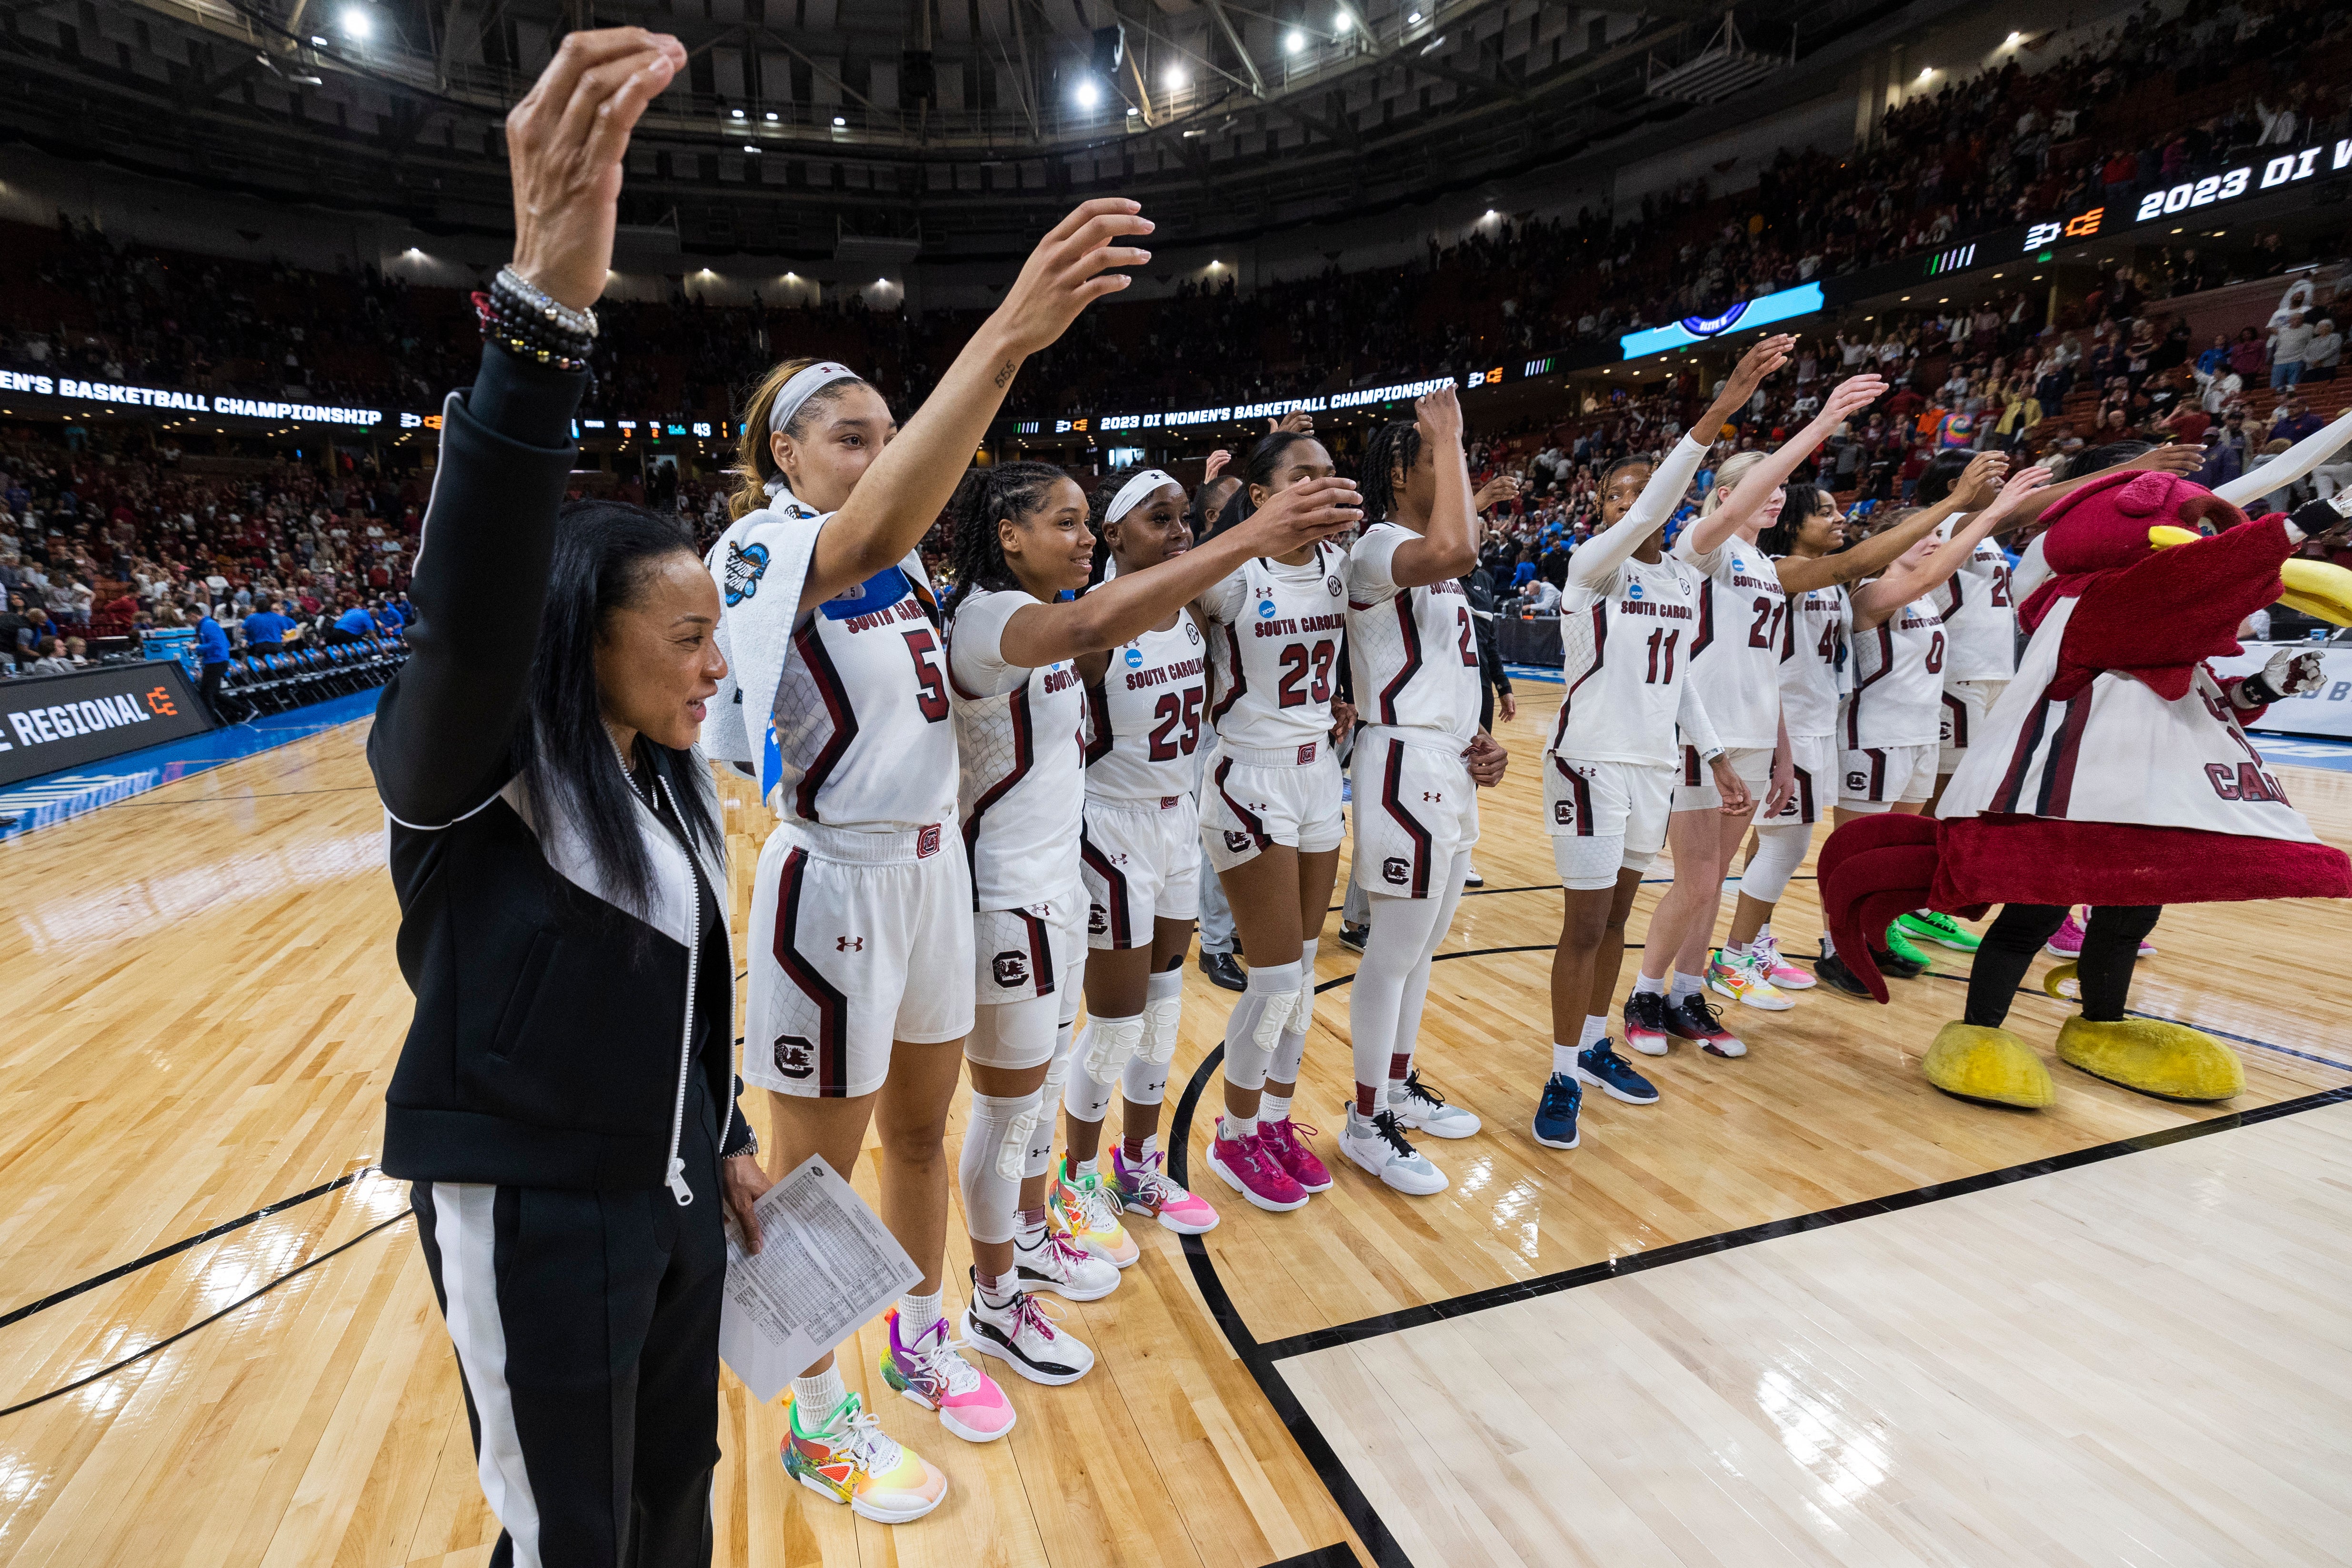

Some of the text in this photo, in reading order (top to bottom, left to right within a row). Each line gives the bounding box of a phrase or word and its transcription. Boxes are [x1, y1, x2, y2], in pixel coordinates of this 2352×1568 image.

[2136, 167, 2252, 222] 2023
[2260, 146, 2323, 190] DI
[59, 379, 210, 411] BASKETBALL
[214, 397, 381, 425] CHAMPIONSHIP
[1101, 377, 1454, 429] 2023 DI WOMEN'S BASKETBALL CHAMPIONSHIP
[623, 428, 631, 438] 3
[652, 428, 659, 438] 2
[693, 423, 711, 437] 43
[850, 587, 855, 597] 5
[1262, 606, 1275, 615] NCAA
[1621, 600, 1656, 616] SOUTH
[845, 608, 895, 634] SOUTH
[1255, 619, 1297, 638] SOUTH
[1748, 596, 1786, 652] 21
[1279, 639, 1335, 709] 23
[1645, 627, 1680, 685] 11
[1926, 631, 1945, 674] 0
[901, 629, 950, 723] 5
[1126, 667, 1168, 690] SOUTH
[8, 693, 150, 746] REGIONAL
[1148, 685, 1204, 762] 25
